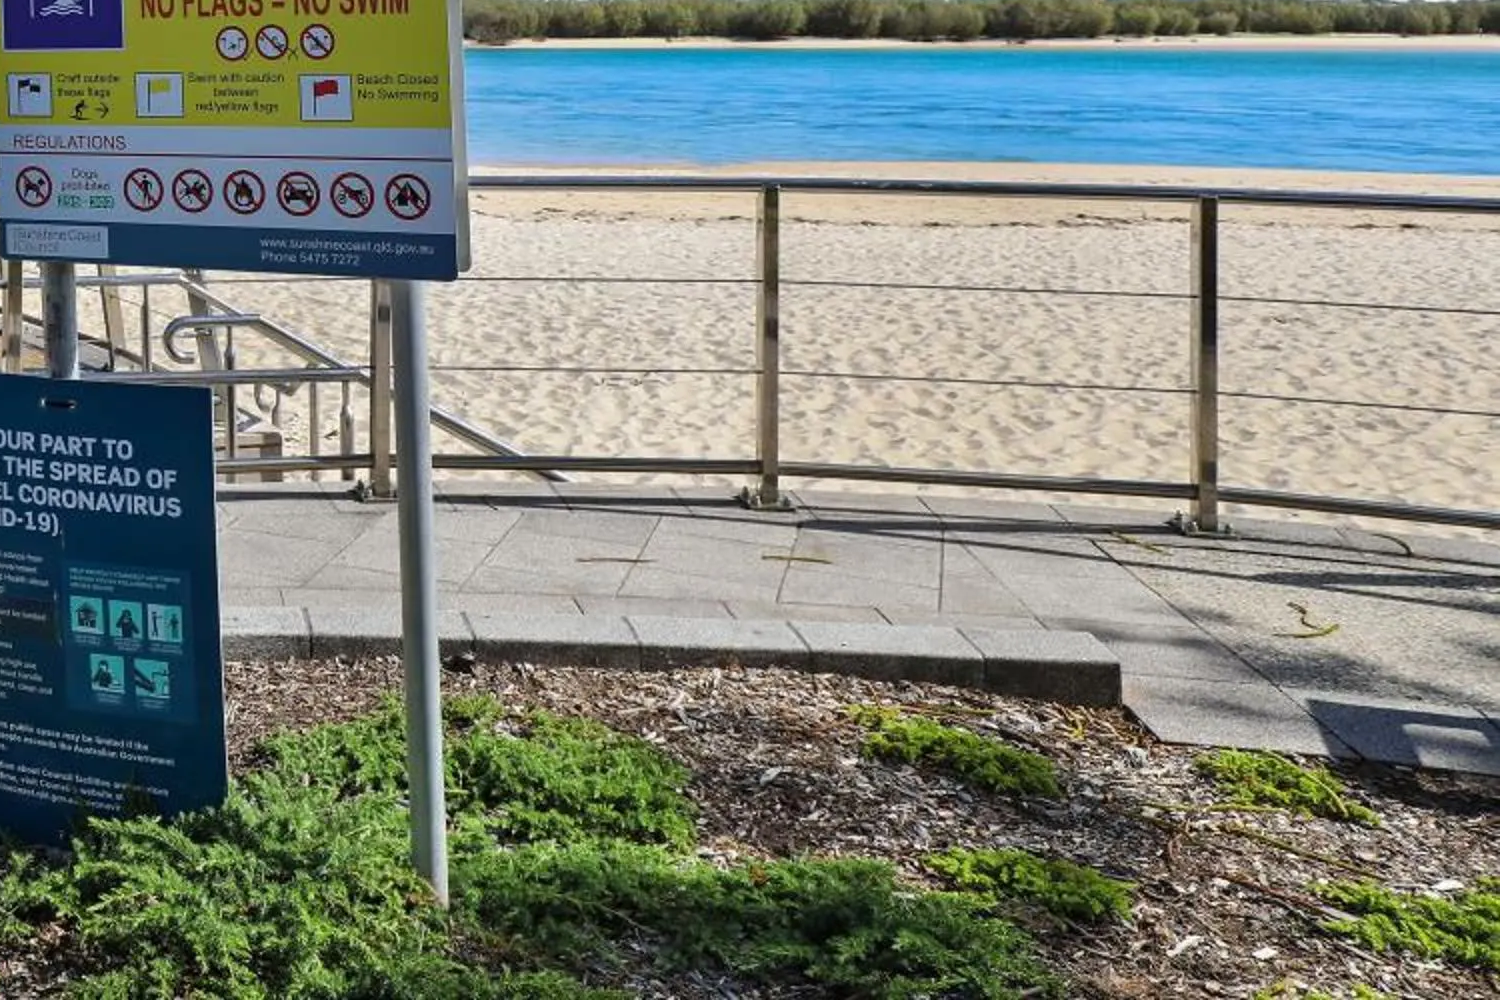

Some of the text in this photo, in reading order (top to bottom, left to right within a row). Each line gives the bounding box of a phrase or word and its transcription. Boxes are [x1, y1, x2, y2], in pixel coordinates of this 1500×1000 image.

[357, 73, 439, 86] Beach Closed
[13, 134, 127, 151] REGULATIONS
[261, 250, 297, 263] Phone
[40, 433, 98, 458] PART
[102, 438, 133, 461] TO
[3, 455, 45, 479] THE
[49, 461, 141, 488] SPREAD
[146, 469, 178, 491] OF
[18, 484, 183, 518] CORONAVIRUS
